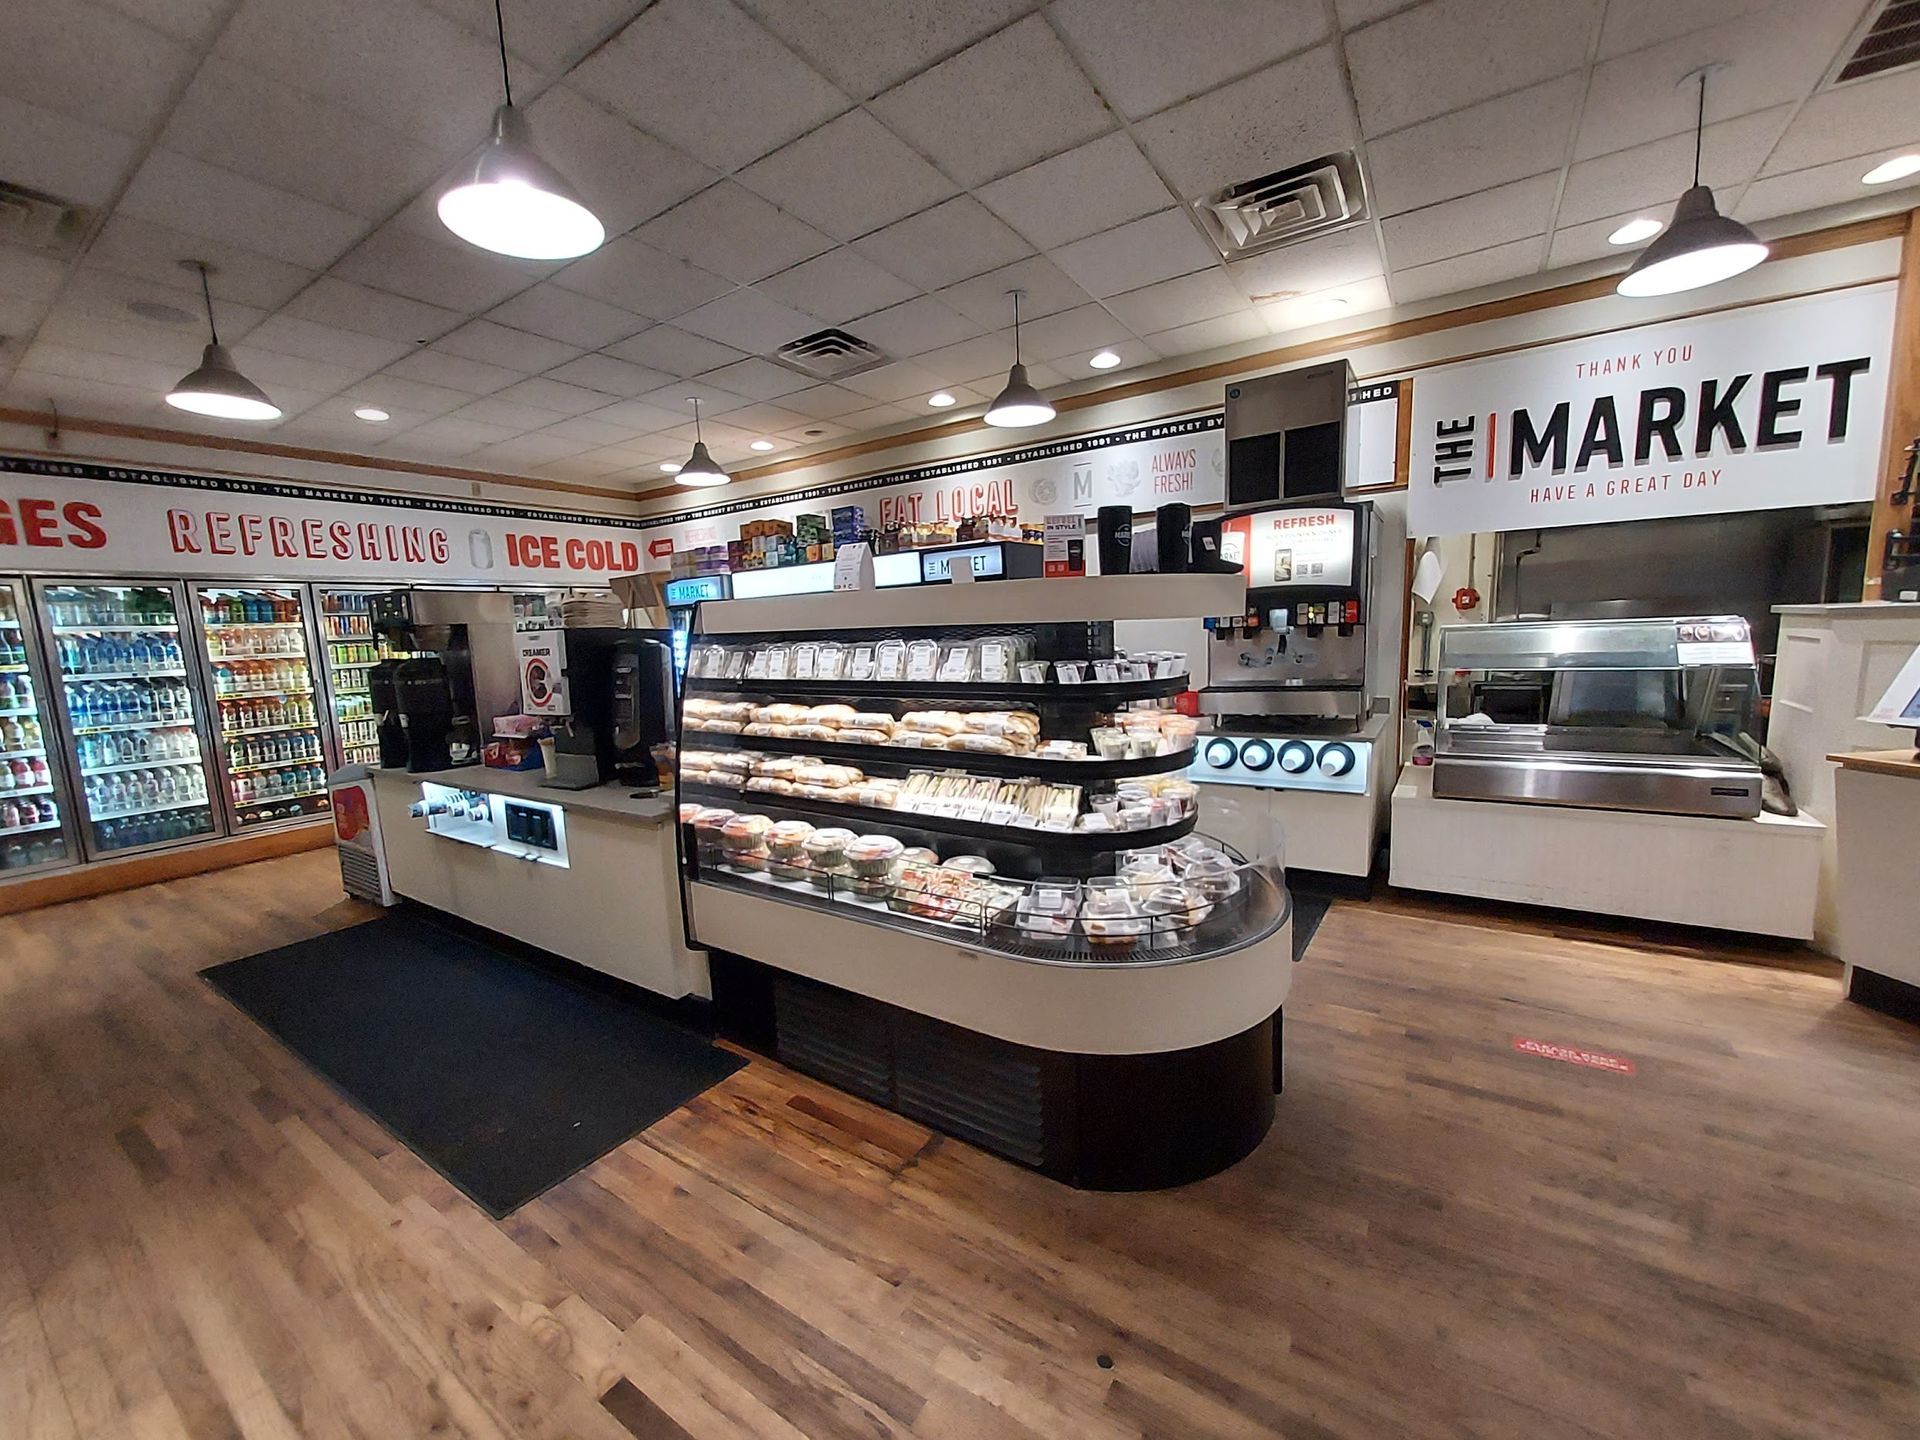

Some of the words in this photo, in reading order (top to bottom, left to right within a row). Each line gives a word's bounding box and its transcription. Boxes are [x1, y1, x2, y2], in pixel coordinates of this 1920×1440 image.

[1576, 353, 1642, 379] THANK
[1653, 344, 1693, 367] YOU
[1508, 356, 1872, 481] MARKET
[703, 506, 726, 517] MARKET
[735, 501, 753, 511] TIGER
[760, 491, 803, 507] ESTABLISHED
[804, 489, 820, 499] 1991
[827, 485, 841, 494] THE
[843, 477, 873, 491] MARKET
[886, 473, 910, 483] TIGER
[920, 460, 979, 478] ESTABLISHED
[981, 456, 1003, 468] 1991
[1014, 441, 1083, 461] ESTABLISHED
[1086, 436, 1111, 449] 1991
[1124, 430, 1148, 442] THE
[1151, 420, 1202, 438] MARKET
[1206, 417, 1224, 428] BY
[1151, 448, 1197, 473] ALWAYS
[1433, 414, 1476, 487] THE
[108, 469, 219, 489] ESTABLISHED
[225, 481, 256, 492] 1991
[273, 486, 300, 496] THE
[304, 489, 354, 501] MARKET
[359, 494, 375, 504] BY
[379, 496, 412, 506] TIGER
[425, 499, 492, 514] ESTABLISHED
[495, 507, 515, 516] 1991
[527, 510, 583, 523] ESTABLISHED
[1153, 472, 1194, 495] FRESH!
[1529, 482, 1577, 504] HAVE
[1585, 482, 1596, 498] A
[1606, 474, 1672, 496] GREAT
[1682, 468, 1724, 488] DAY
[879, 492, 923, 527] EAT
[935, 478, 1019, 526] LOCAL
[1273, 513, 1335, 530] REFRESH
[166, 508, 450, 565] REFRESHING
[506, 533, 561, 569] ICE
[565, 537, 639, 572] COLD
[940, 555, 987, 575] MET
[678, 583, 709, 600] MARKET
